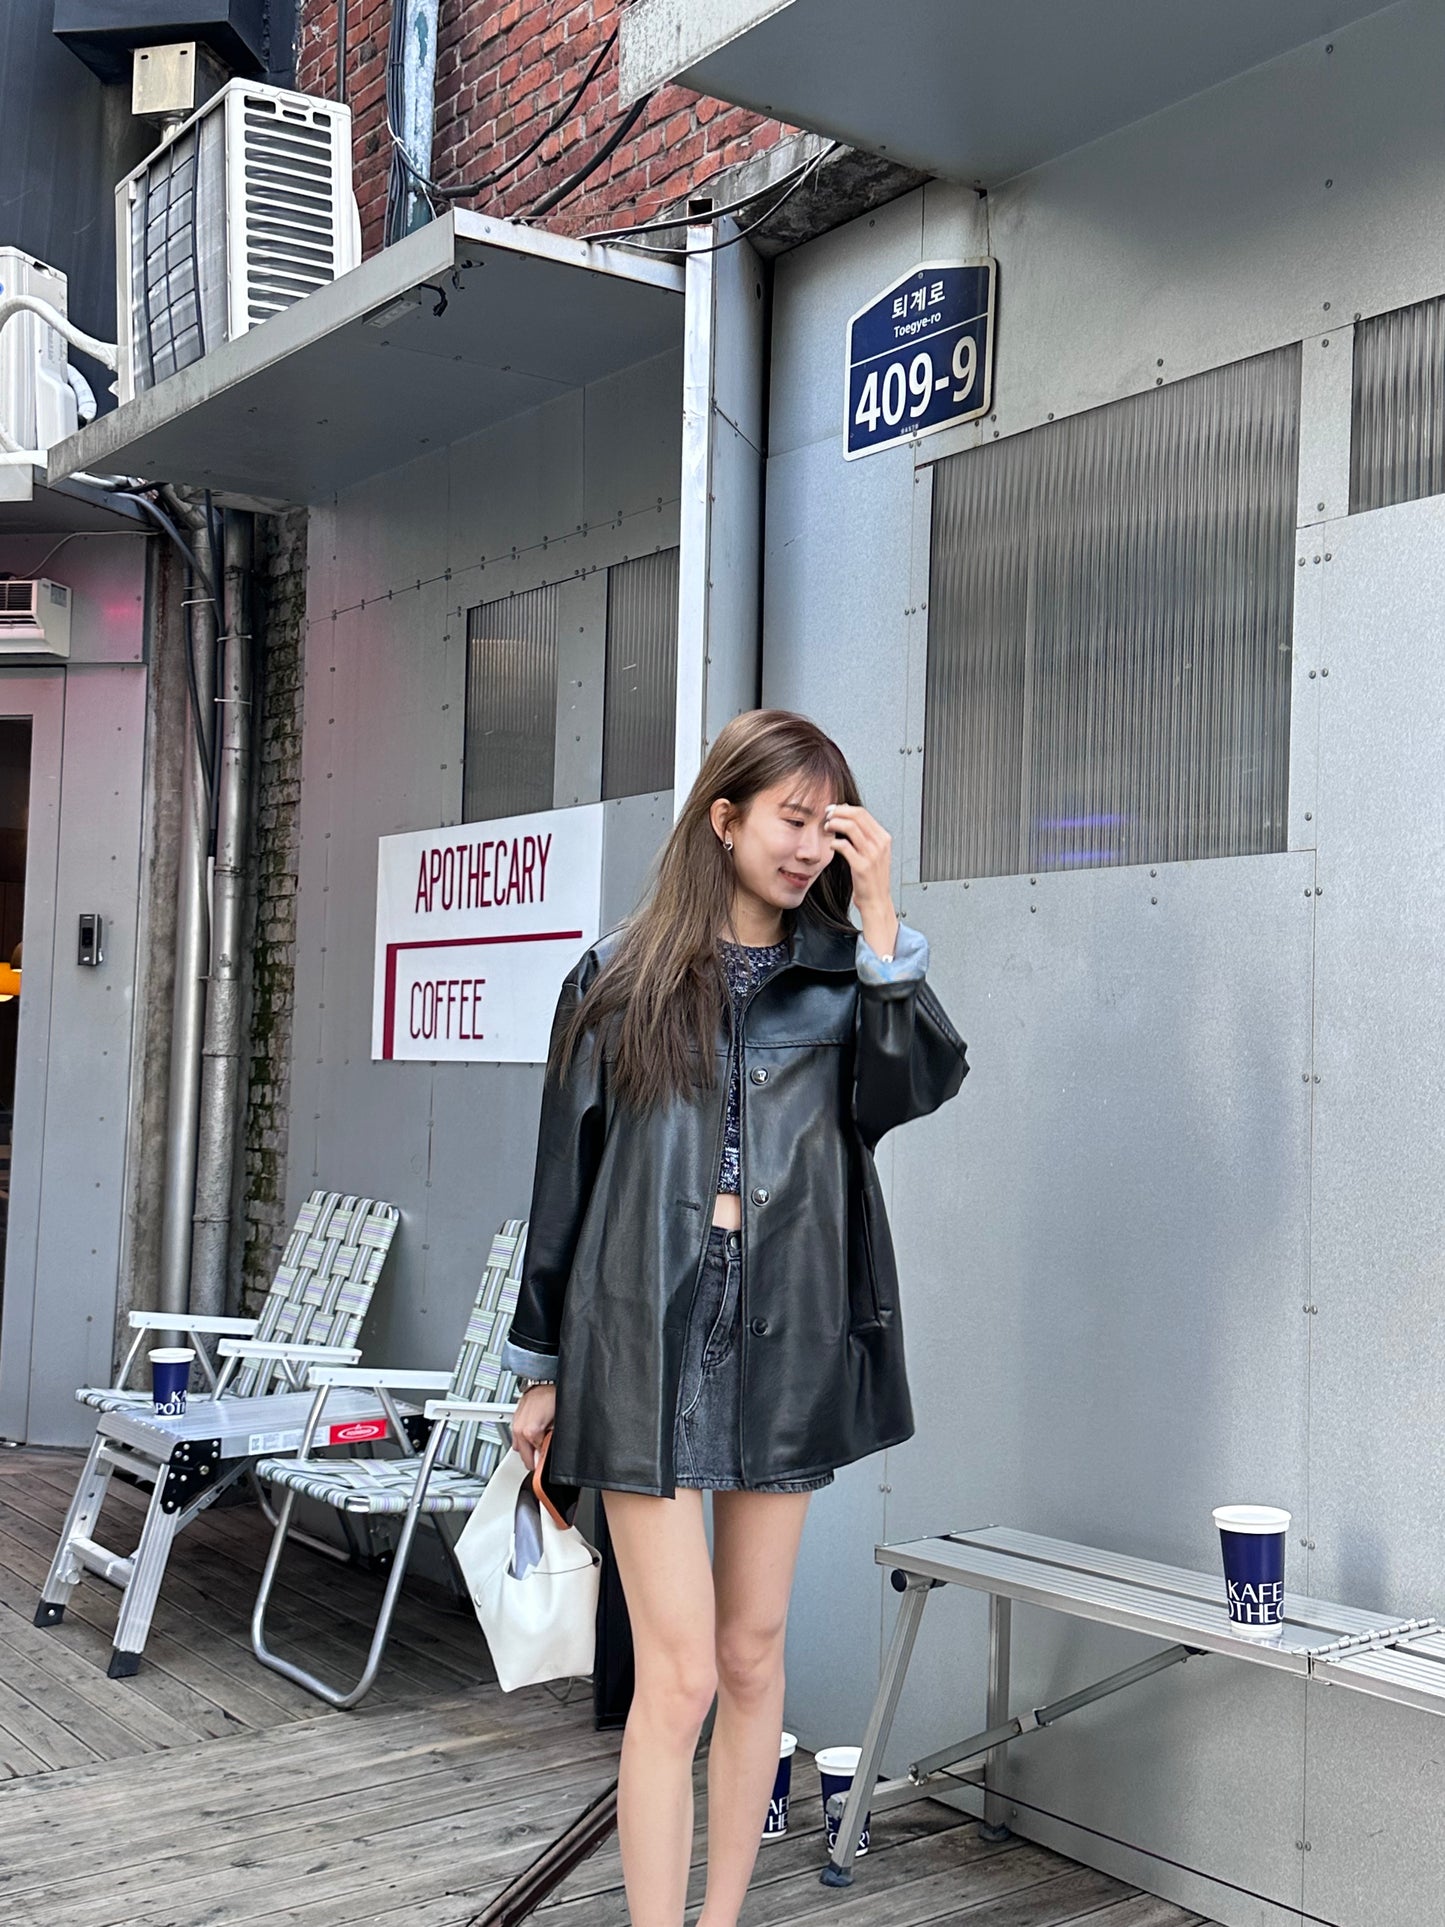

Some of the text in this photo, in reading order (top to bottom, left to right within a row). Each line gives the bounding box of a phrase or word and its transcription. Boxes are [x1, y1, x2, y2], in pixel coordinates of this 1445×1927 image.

[891, 280, 946, 319] 퇴계로
[893, 312, 942, 338] Toegye-ro
[855, 335, 978, 432] 409-9
[415, 833, 552, 913] APOTHECARY
[409, 979, 486, 1040] COFFEE
[1228, 1579, 1283, 1603] KAFE
